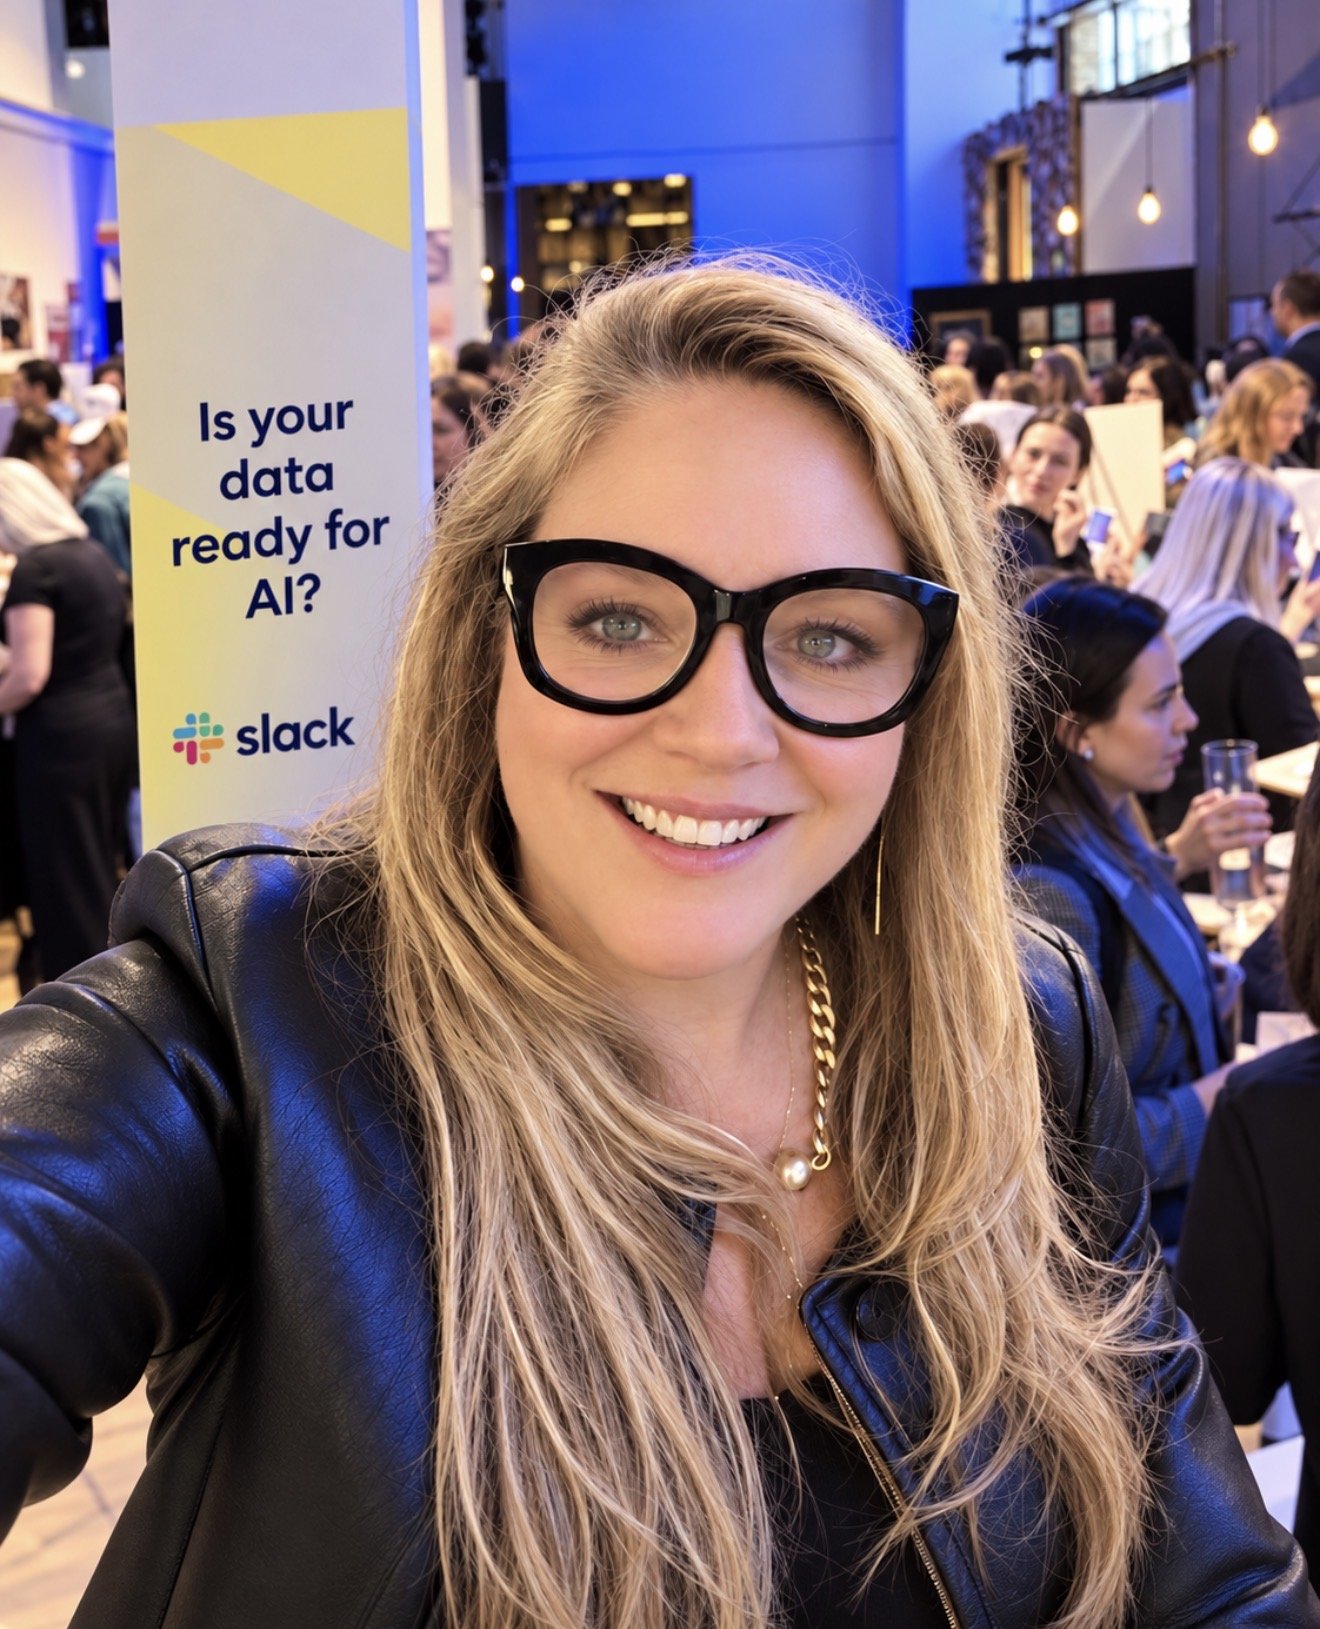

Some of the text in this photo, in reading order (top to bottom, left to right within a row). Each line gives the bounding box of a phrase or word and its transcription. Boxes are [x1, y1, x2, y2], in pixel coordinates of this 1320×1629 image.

[200, 400, 354, 448] Is your
[220, 458, 333, 500] data
[173, 508, 390, 566] ready for
[246, 573, 320, 618] AI?
[237, 707, 355, 755] slack
